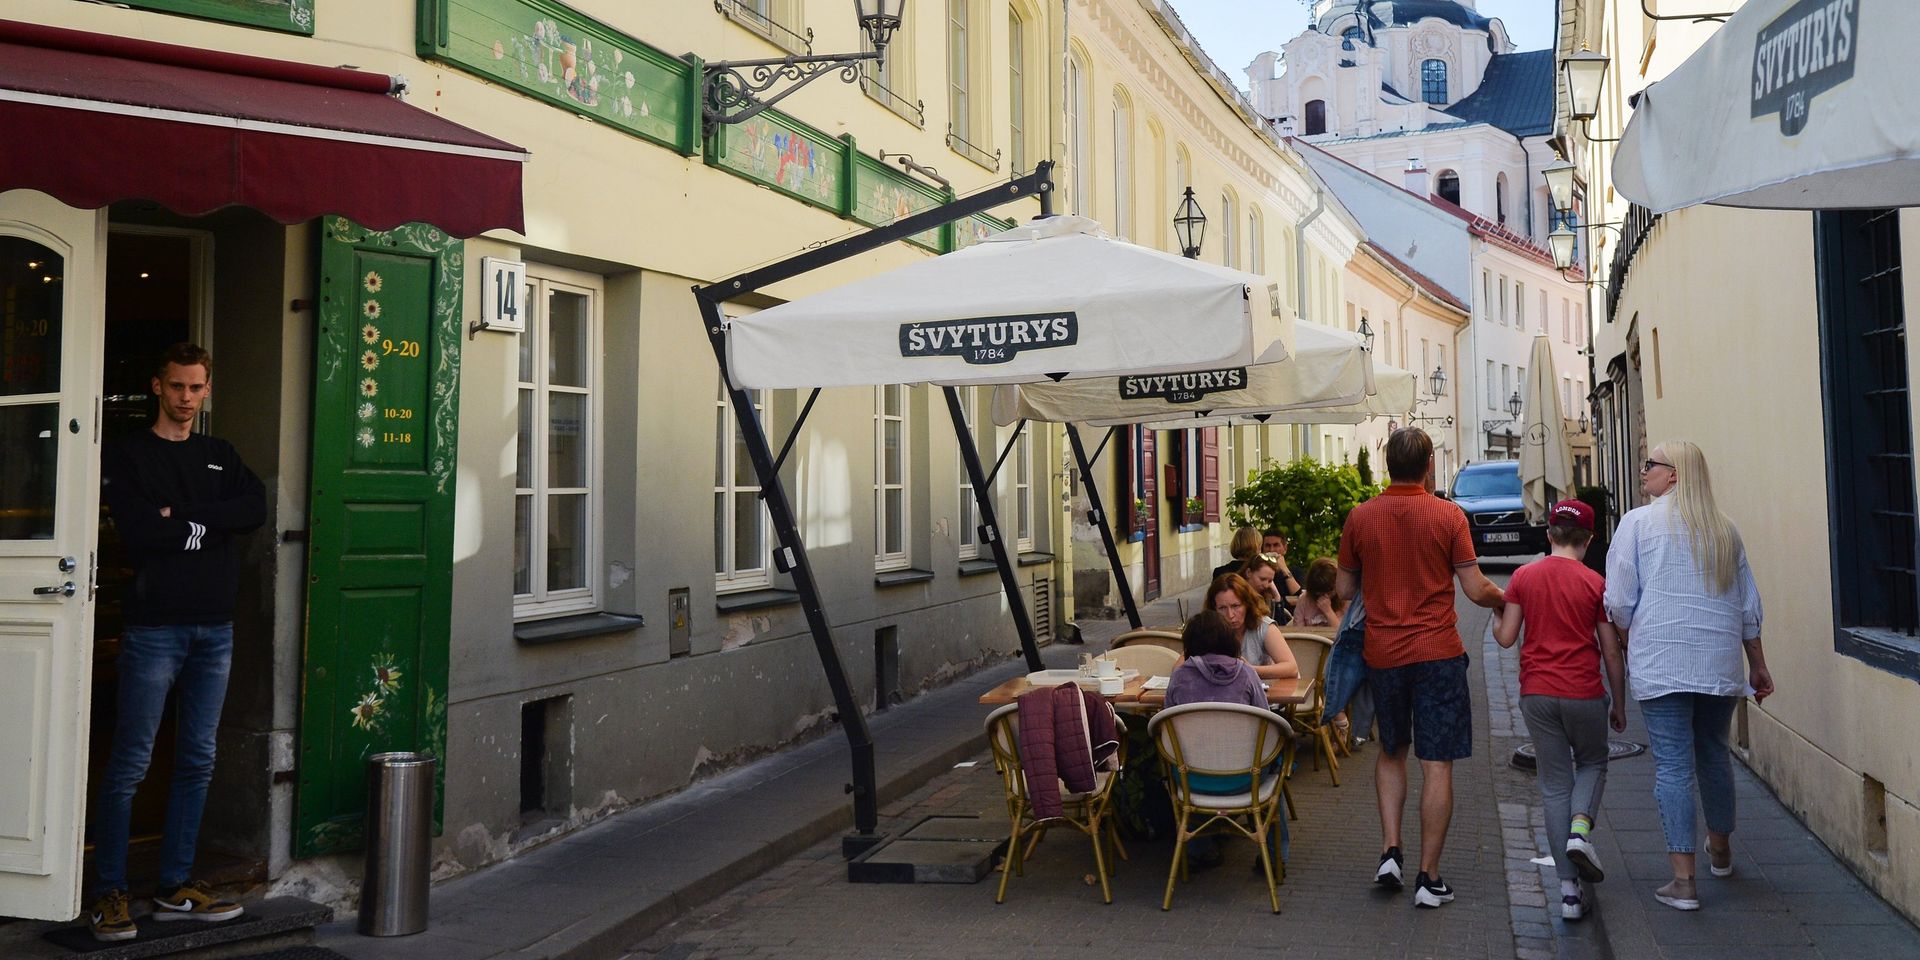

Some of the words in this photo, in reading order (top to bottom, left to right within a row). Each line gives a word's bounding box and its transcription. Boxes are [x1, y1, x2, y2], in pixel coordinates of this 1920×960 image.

[1755, 0, 1853, 100] ŠVYTURYS
[1785, 90, 1805, 121] 1784
[496, 269, 517, 321] 14
[908, 317, 1069, 351] ŠVYTURYS
[382, 339, 420, 358] 9-20
[974, 348, 1005, 360] 1784
[1125, 369, 1241, 395] ŠVYTURYS
[1173, 392, 1195, 401] 1784
[384, 408, 412, 419] 10-20
[383, 432, 411, 443] 11-18
[1555, 505, 1581, 516] LONDON
